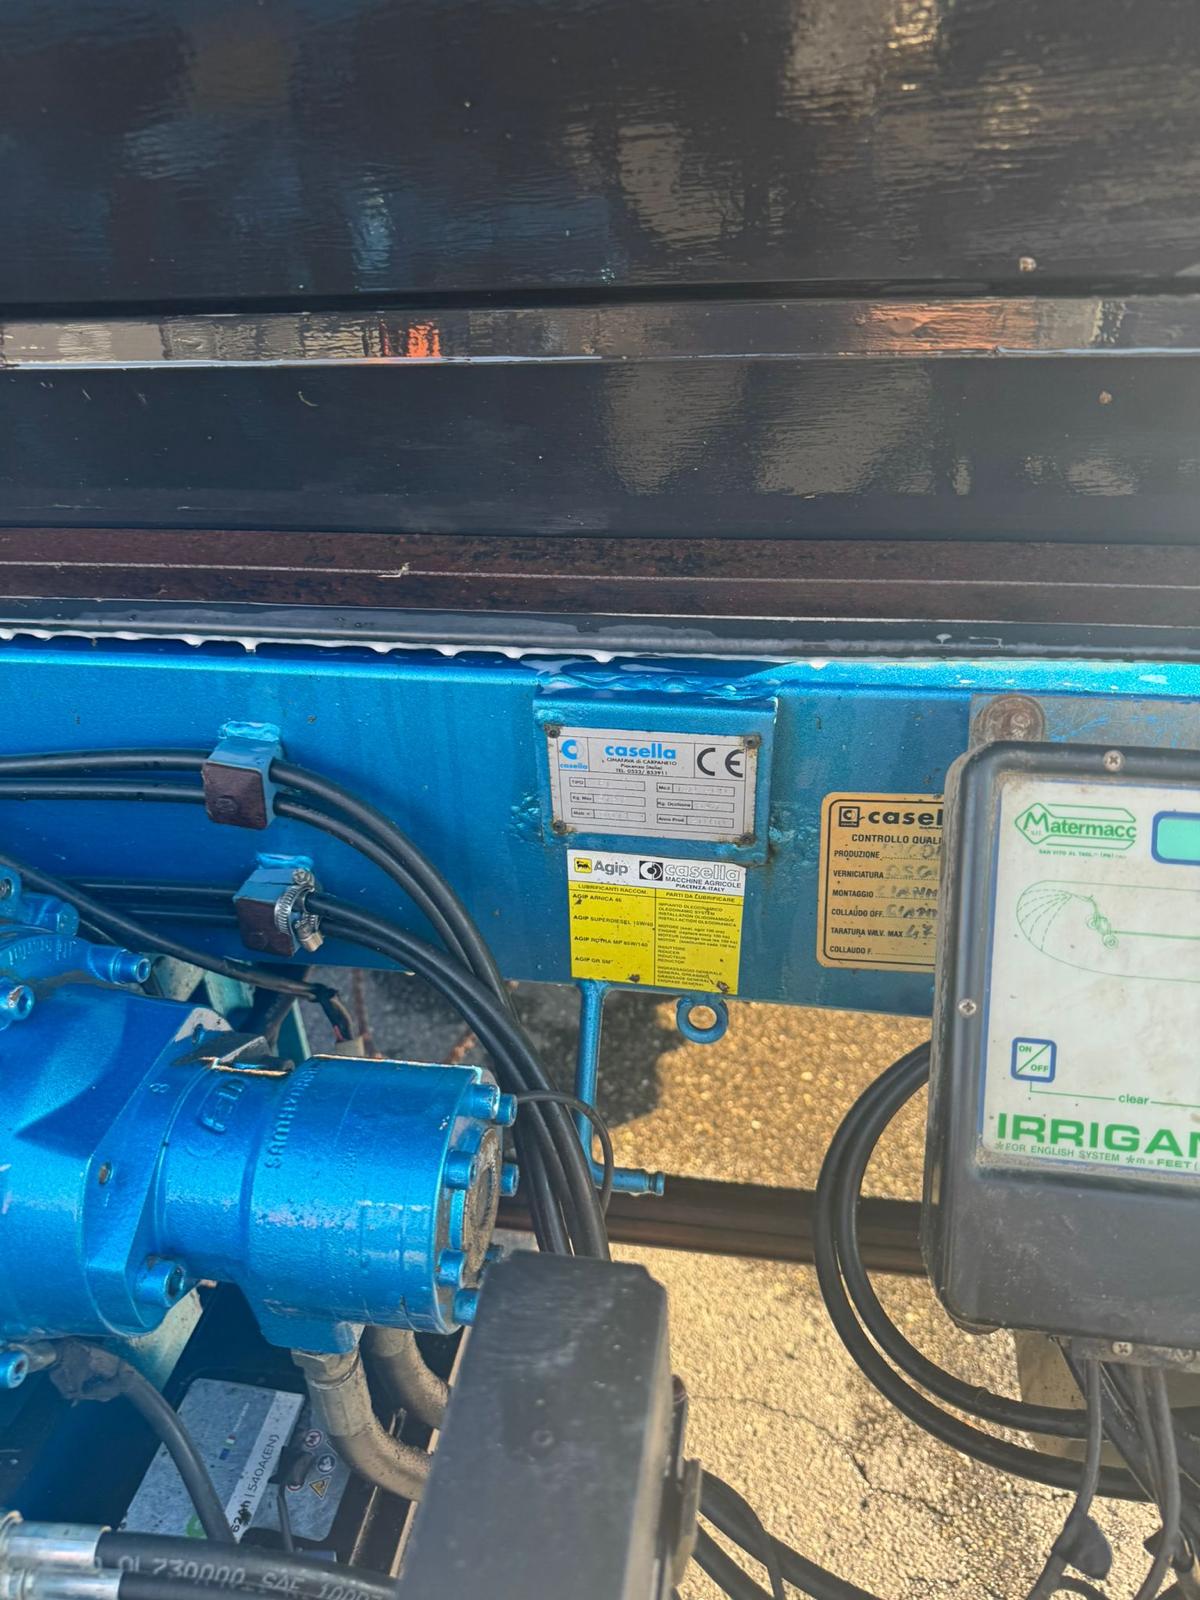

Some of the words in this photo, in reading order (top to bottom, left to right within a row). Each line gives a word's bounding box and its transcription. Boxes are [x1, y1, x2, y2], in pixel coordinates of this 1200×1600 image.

[605, 743, 676, 760] casella
[697, 747, 744, 778] CE
[868, 809, 943, 826] casel
[1023, 811, 1137, 838] Matermacc
[852, 834, 910, 844] CONTROLLO
[834, 850, 881, 859] PRODUZIONE
[594, 861, 628, 876] Agip
[665, 864, 740, 881] casella
[833, 870, 884, 879] VERNICIATURA
[665, 876, 703, 886] MACCHINE
[704, 880, 741, 889] AGRICOLE
[578, 884, 620, 893] LUBRIFICANTI
[832, 889, 874, 898] MONTAGGIO
[831, 908, 868, 917] COLLAUDO
[590, 916, 632, 925] SUPERDIESEL
[831, 927, 866, 936] TARATURA
[829, 946, 866, 954] COLLAUDO
[1018, 1045, 1032, 1053] ON
[1030, 1064, 1049, 1073] OFF
[1118, 1093, 1150, 1105] clear
[1031, 1145, 1074, 1158] ENGLISH
[1078, 1150, 1120, 1162] SYSTEM
[1157, 1159, 1191, 1169] FEET
[247, 1434, 280, 1492] 540A(EN)
